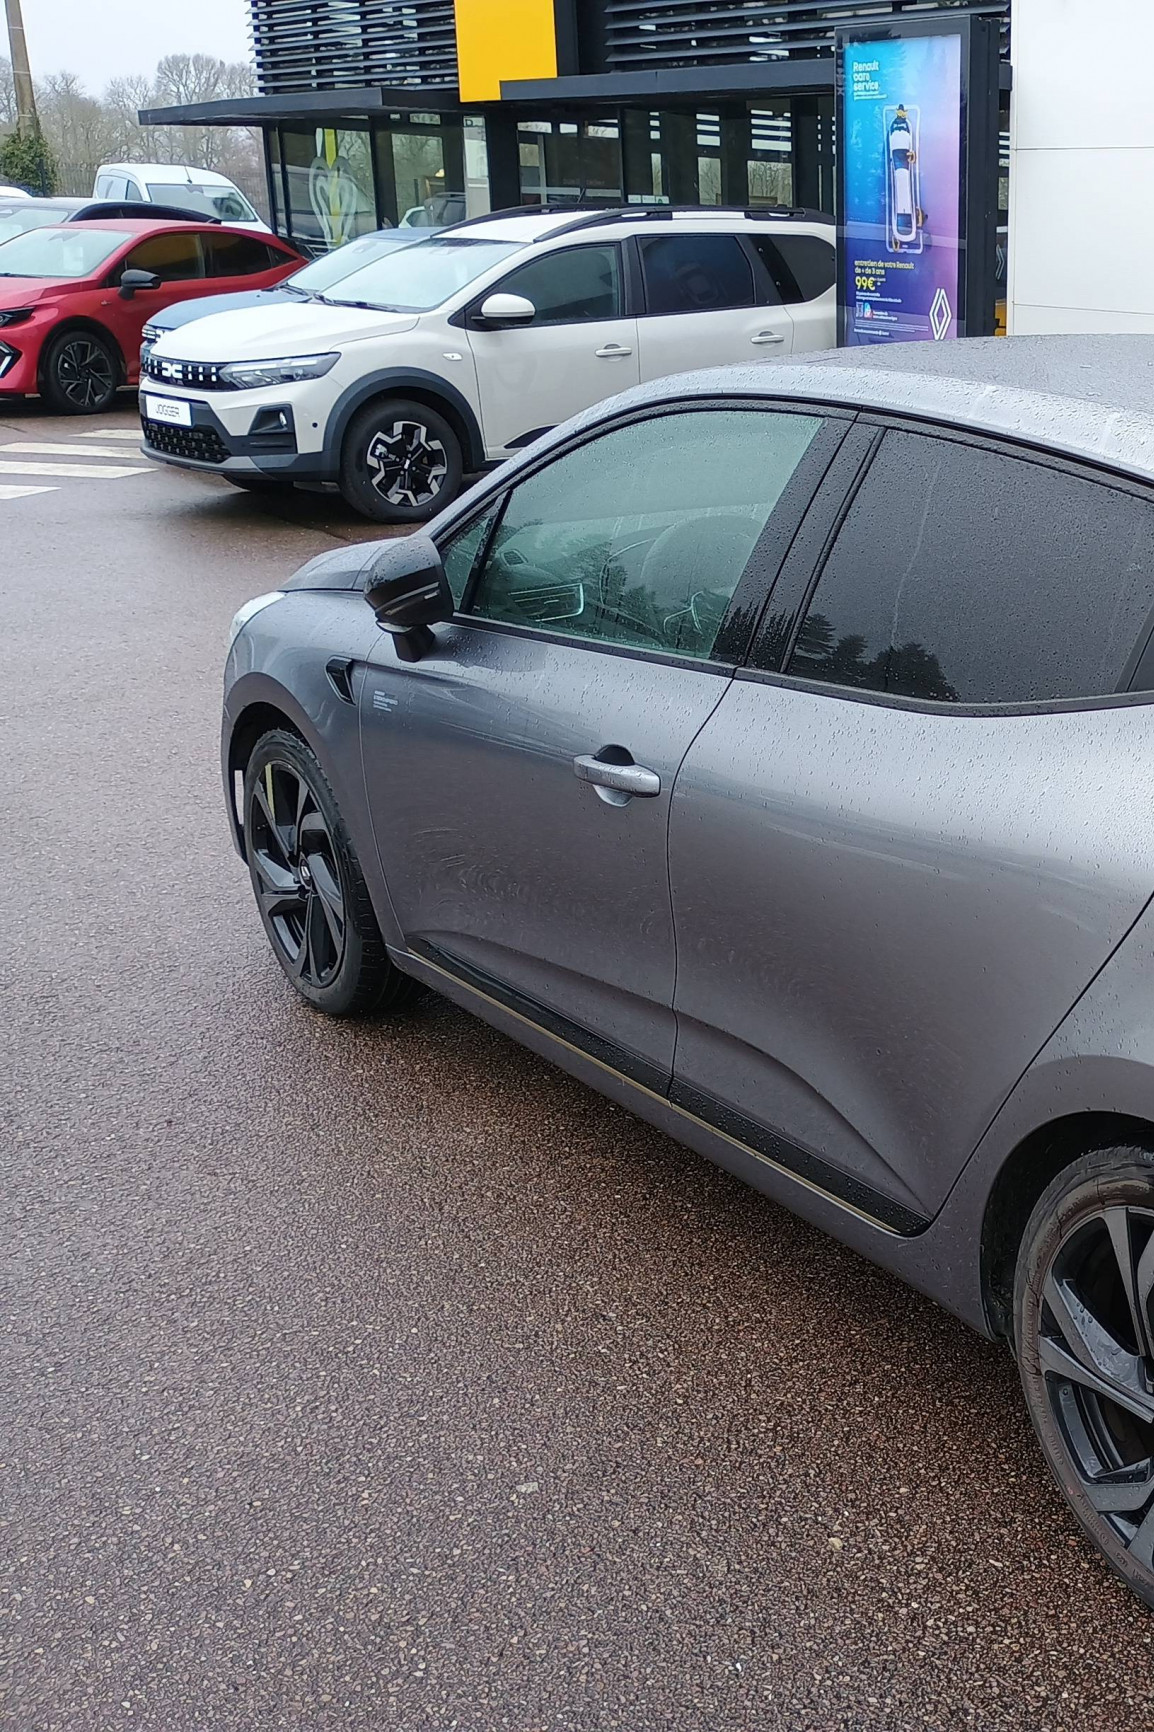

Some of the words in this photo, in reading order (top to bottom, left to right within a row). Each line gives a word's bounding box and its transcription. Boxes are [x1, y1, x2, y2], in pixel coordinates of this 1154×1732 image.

[853, 60, 879, 71] Renault
[853, 80, 879, 91] service
[855, 276, 875, 290] 99€
[156, 404, 180, 417] JOGGER
